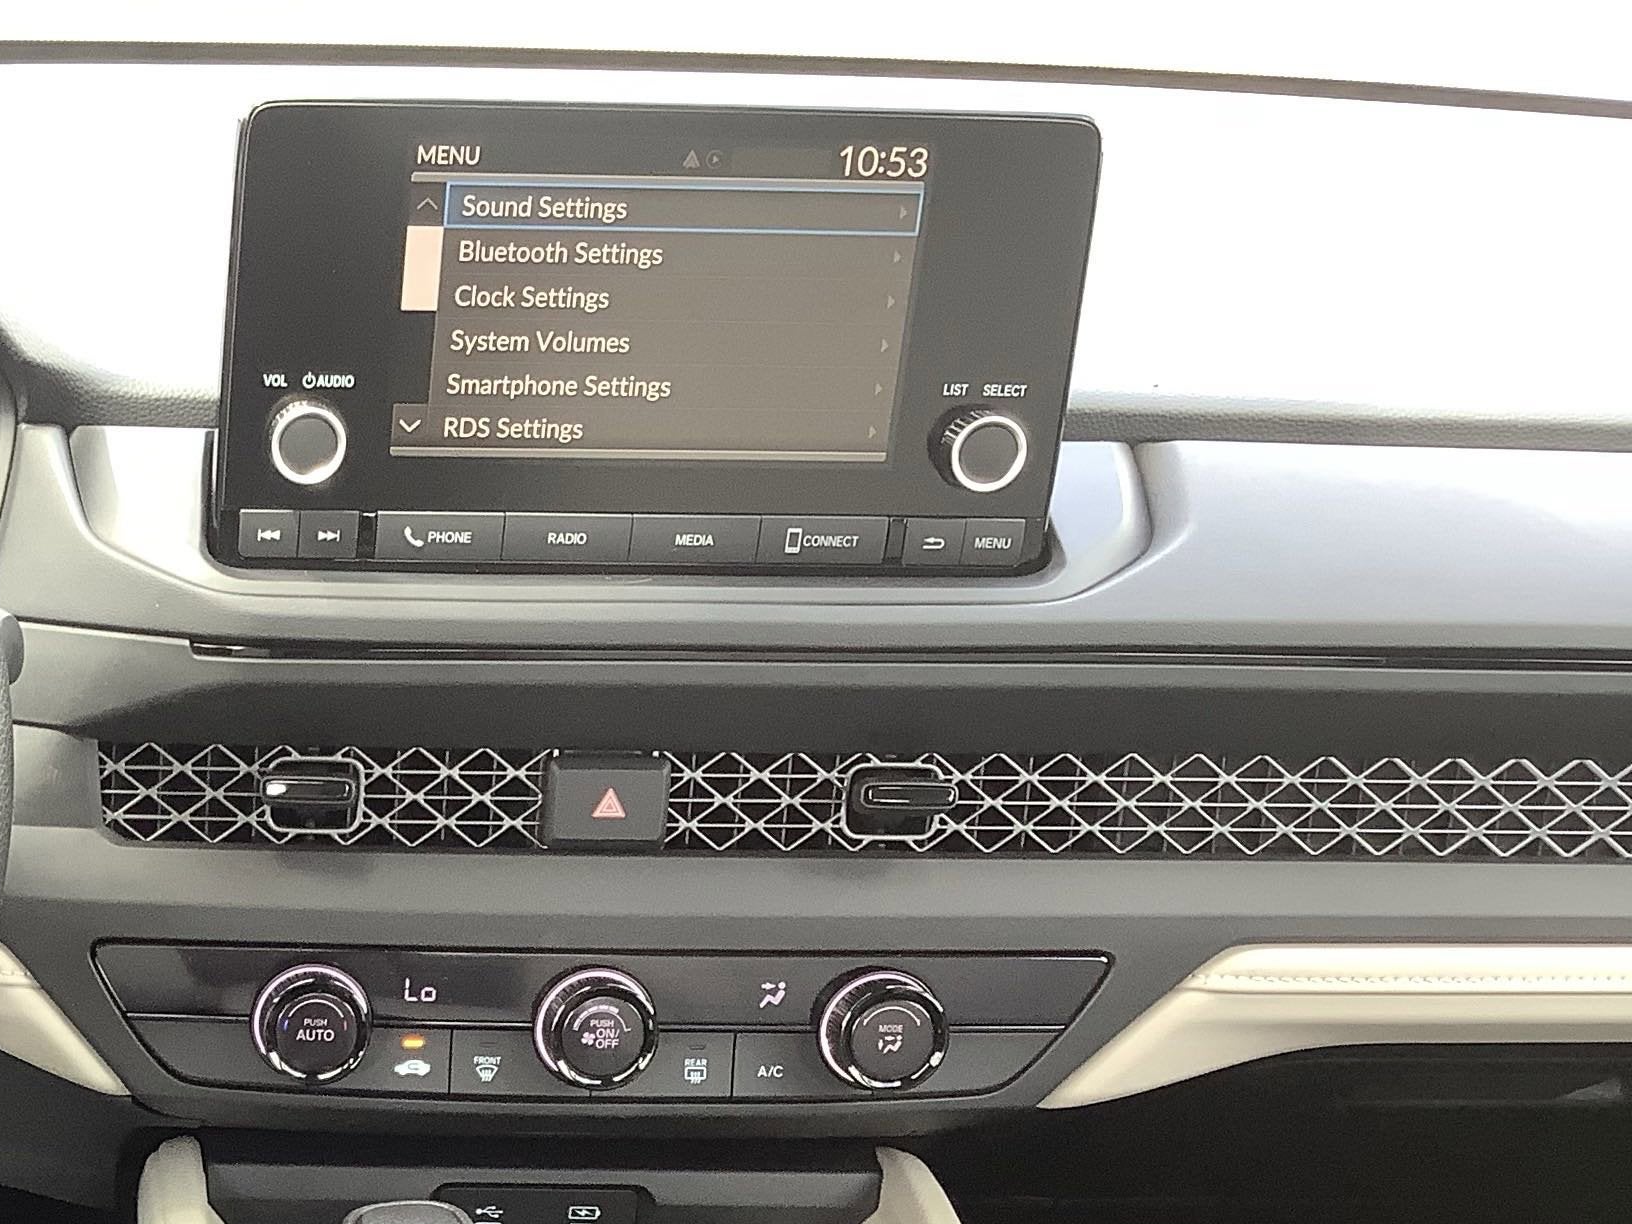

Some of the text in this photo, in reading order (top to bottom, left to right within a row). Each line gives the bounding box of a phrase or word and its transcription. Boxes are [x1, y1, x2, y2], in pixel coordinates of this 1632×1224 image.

[417, 144, 481, 166] MENU
[839, 145, 929, 178] 10:53
[462, 194, 628, 224] Sound Settings
[458, 239, 664, 269] Bluetooth Settings
[454, 285, 610, 313] Clock Settings
[449, 329, 630, 356] System Volumes
[262, 373, 355, 388] VOL AUDIO
[446, 373, 672, 402] Smartphone Settings
[943, 383, 1028, 397] LIST SELECT
[443, 417, 584, 443] RDS Settings
[426, 530, 473, 544] PHONE
[546, 532, 587, 545] RADIO
[674, 533, 715, 547] MEDIA
[802, 534, 860, 548] CONNECT
[974, 536, 1014, 550] MENU
[303, 1018, 328, 1027] PUSH
[589, 1019, 615, 1028] PUSH
[879, 1024, 904, 1033] MODE
[295, 1029, 335, 1042] AUTO
[595, 1038, 619, 1049] OFF
[473, 1056, 502, 1065] FRONT
[684, 1058, 708, 1067] REAR
[757, 1065, 784, 1079] A/C
